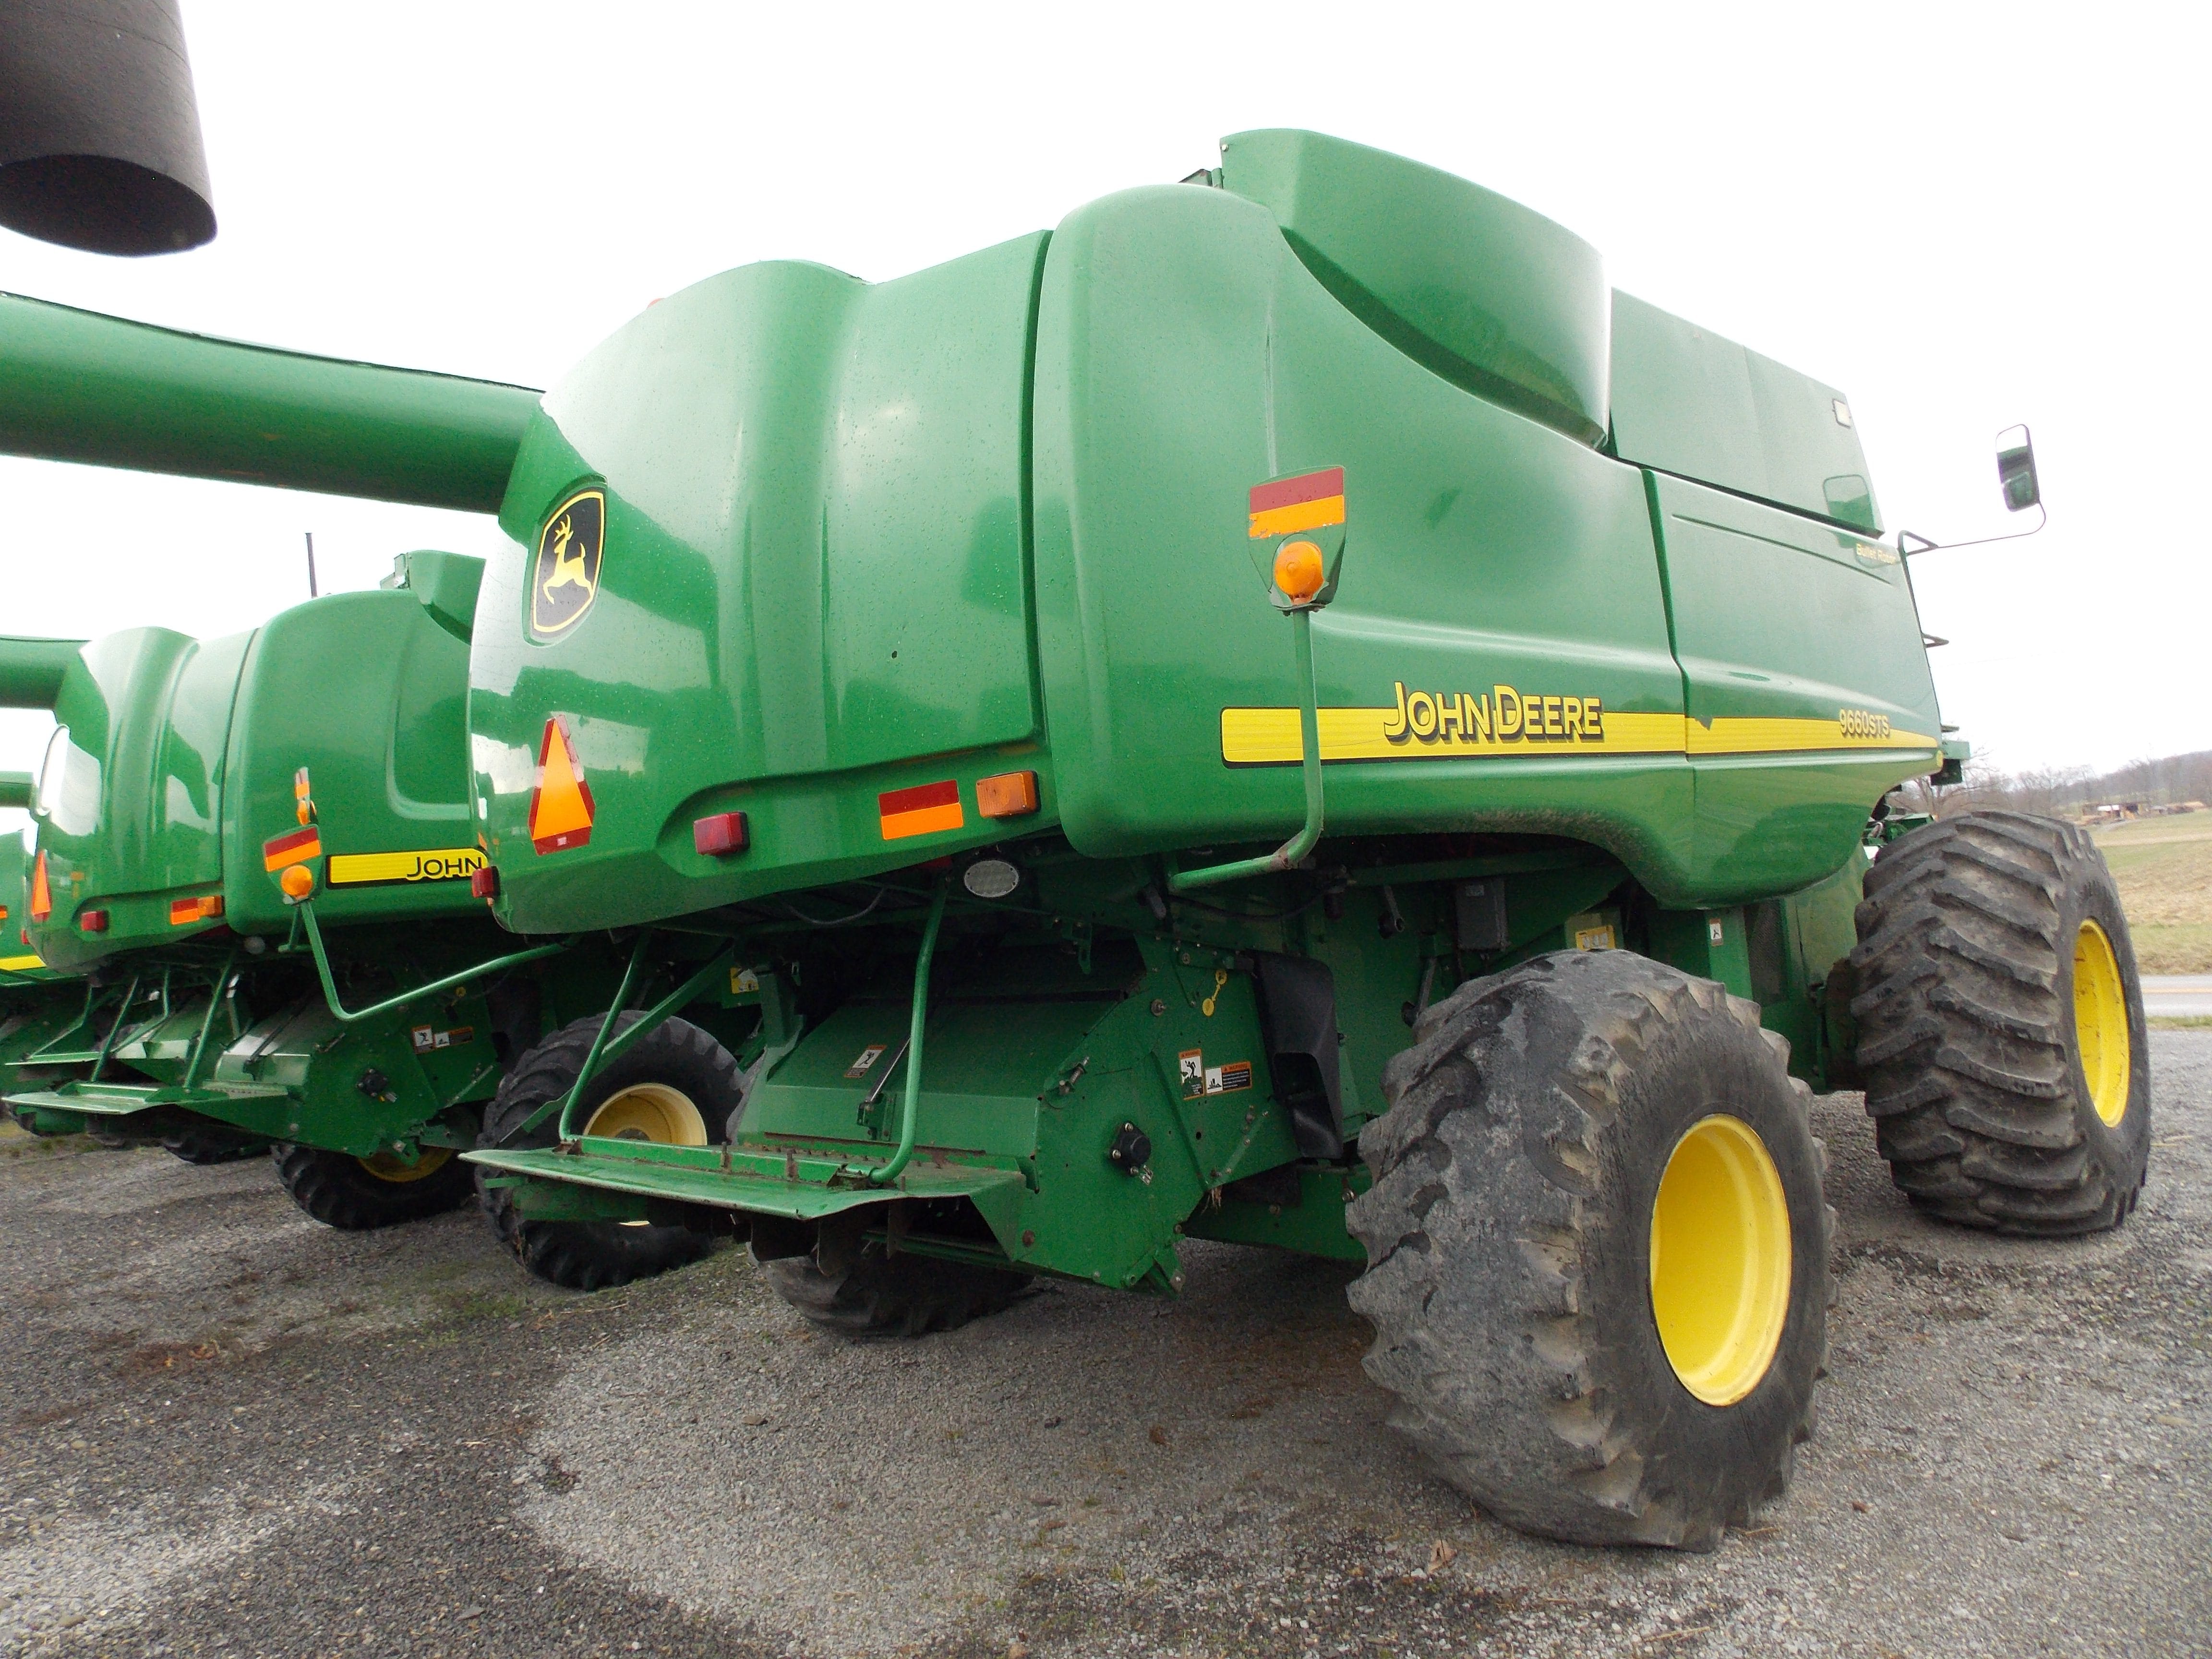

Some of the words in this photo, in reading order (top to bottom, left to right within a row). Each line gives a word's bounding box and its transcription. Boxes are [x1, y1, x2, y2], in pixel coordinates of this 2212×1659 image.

[1384, 681, 1493, 743] JOHN
[1493, 684, 1602, 743] DEERE
[1839, 709, 1890, 737] 9660STS
[407, 856, 482, 878] JOHN
